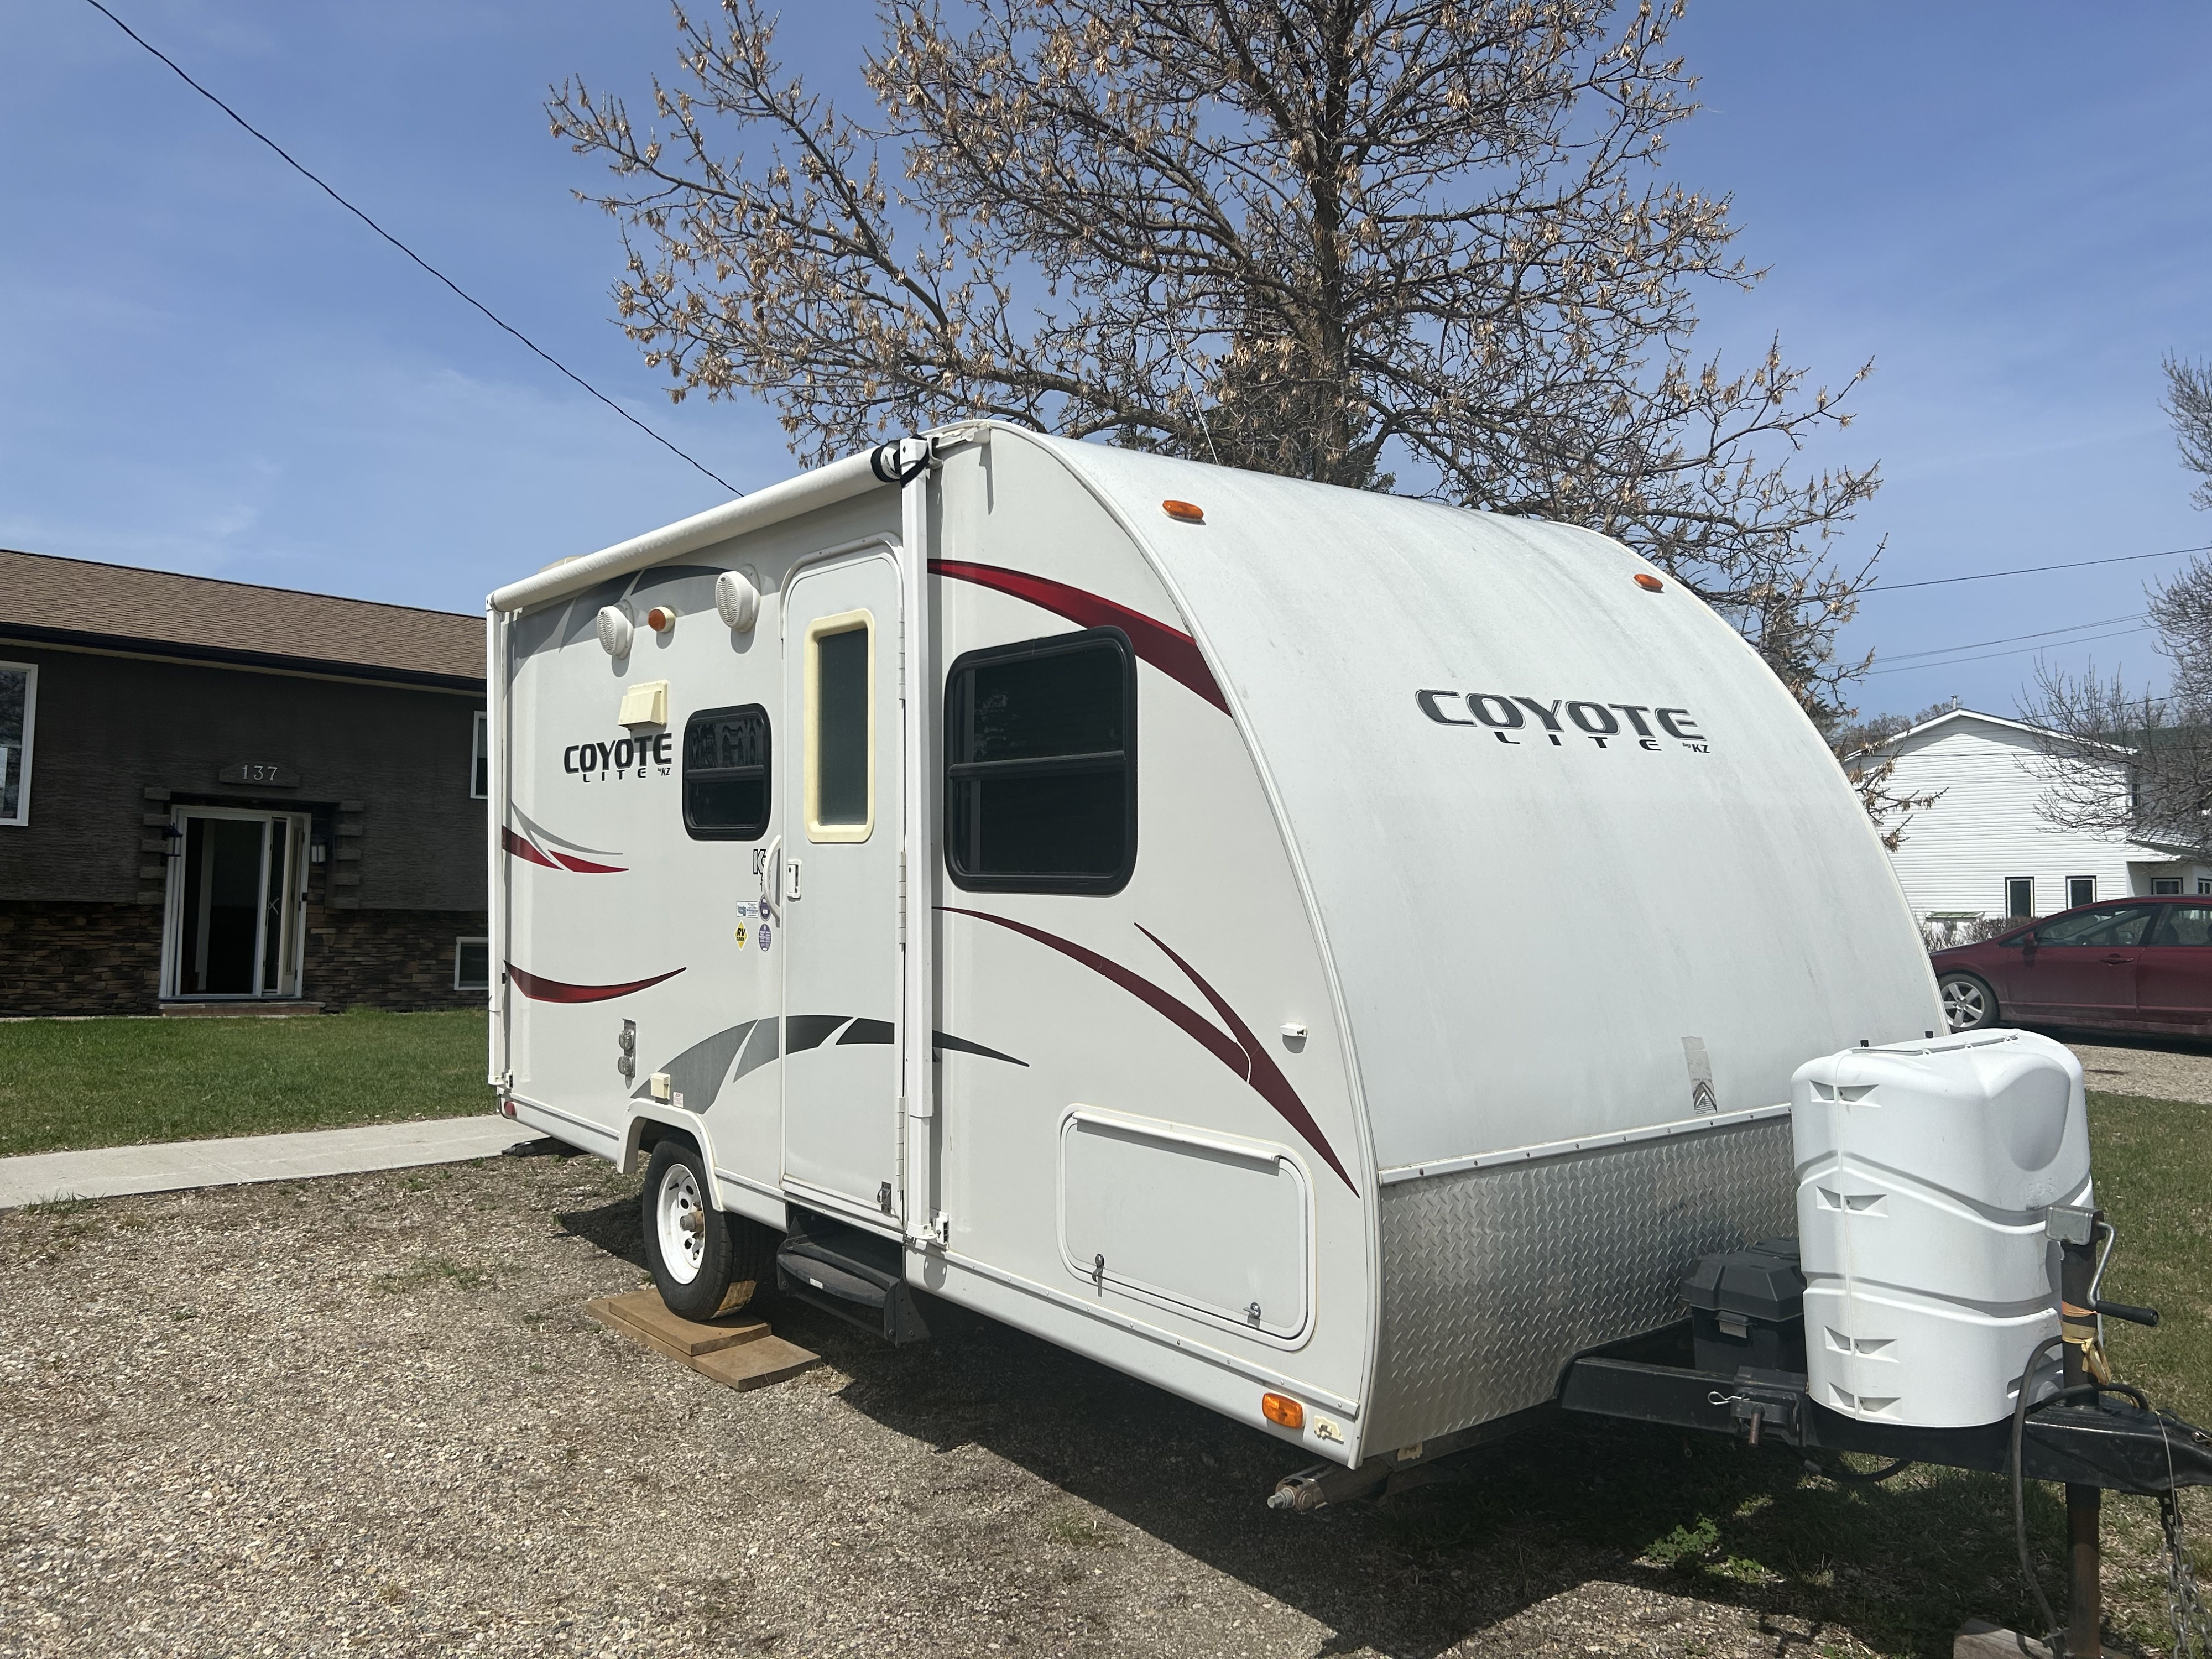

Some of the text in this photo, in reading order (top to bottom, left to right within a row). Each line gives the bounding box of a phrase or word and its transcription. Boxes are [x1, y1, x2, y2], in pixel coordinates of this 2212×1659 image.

[1415, 689, 1707, 741] COYOTE
[1494, 732, 1662, 751] LITE
[1692, 744, 1710, 753] KZ
[564, 733, 672, 774] COYOTE
[242, 765, 278, 781] 137
[583, 768, 646, 782] LITE
[661, 767, 671, 776] KZ
[737, 927, 746, 937] RV
